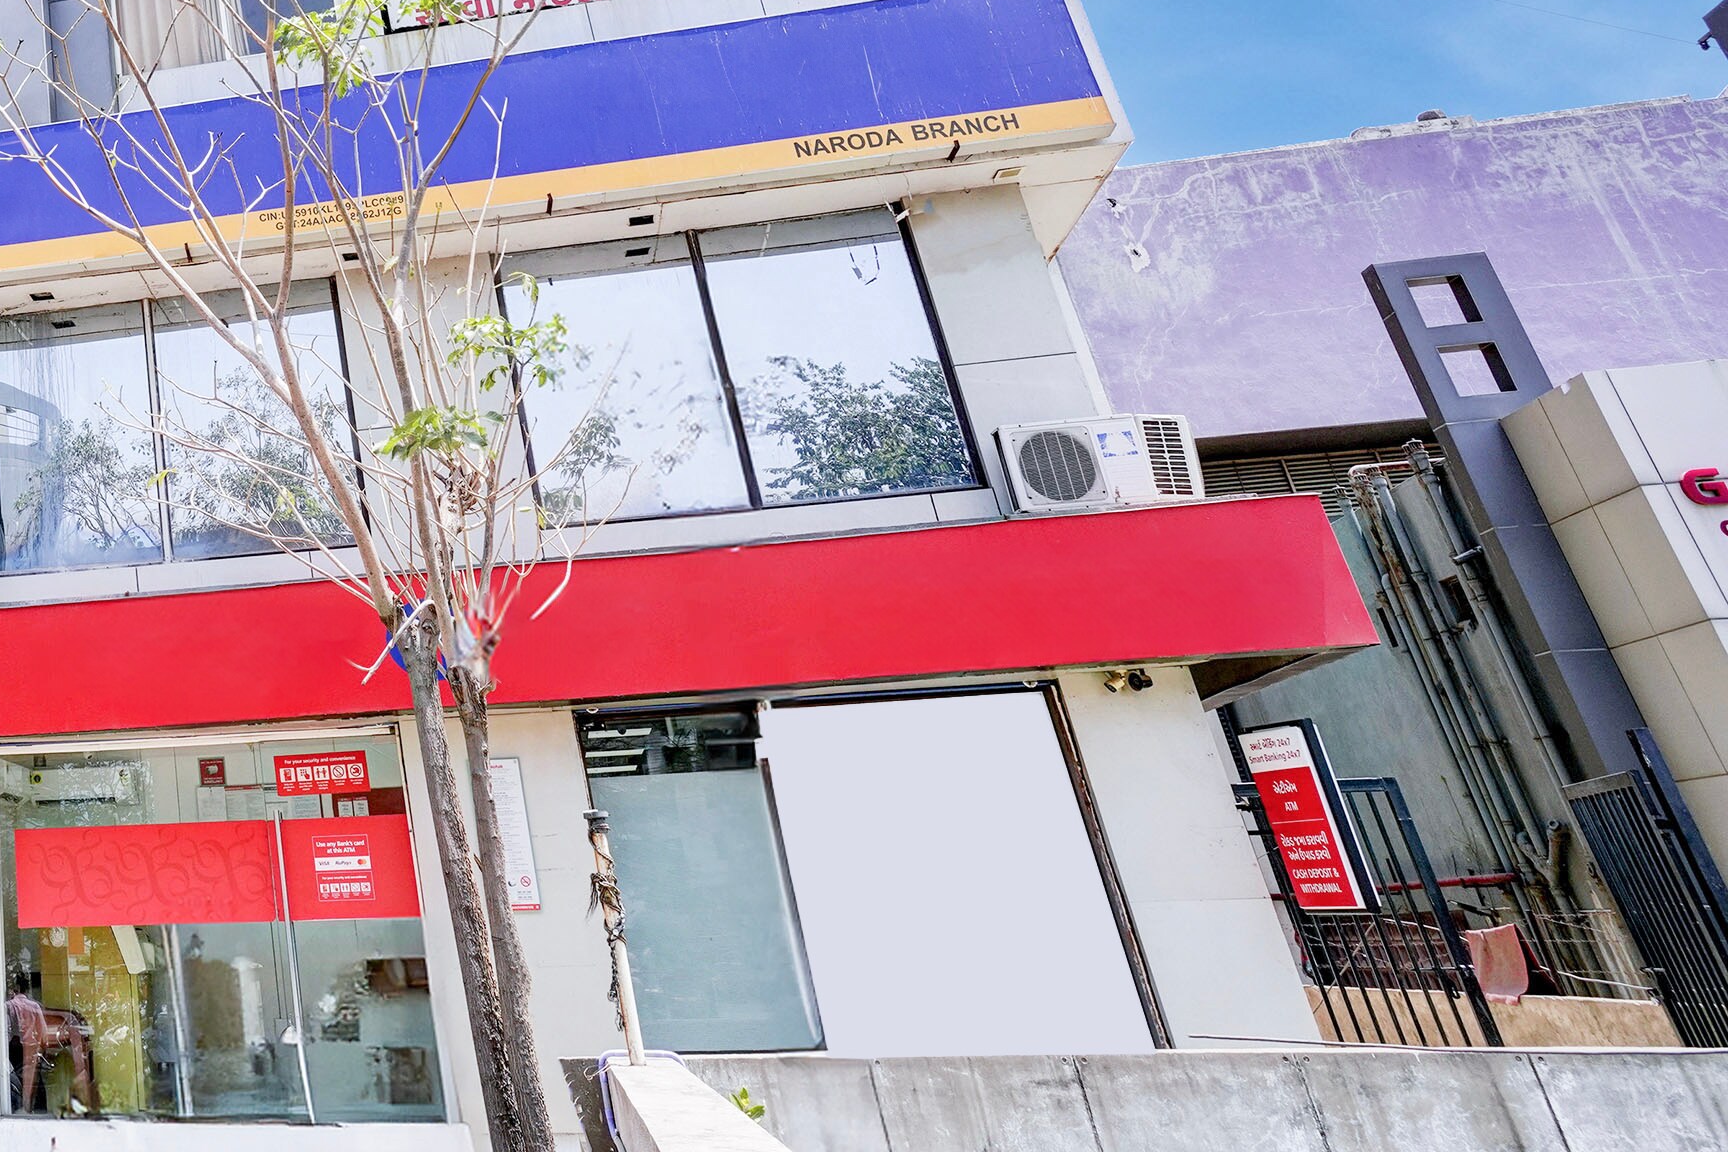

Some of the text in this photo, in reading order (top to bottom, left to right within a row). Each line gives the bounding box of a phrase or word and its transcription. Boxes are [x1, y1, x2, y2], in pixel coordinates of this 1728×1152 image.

[793, 112, 1020, 159] NARODA BRANCH
[1249, 756, 1264, 765] Smart
[1264, 752, 1286, 762] Banking
[1284, 800, 1299, 812] ATM
[1292, 867, 1340, 879] CASH DEPOSIT &
[1300, 883, 1342, 894] WITHDRAWAL
